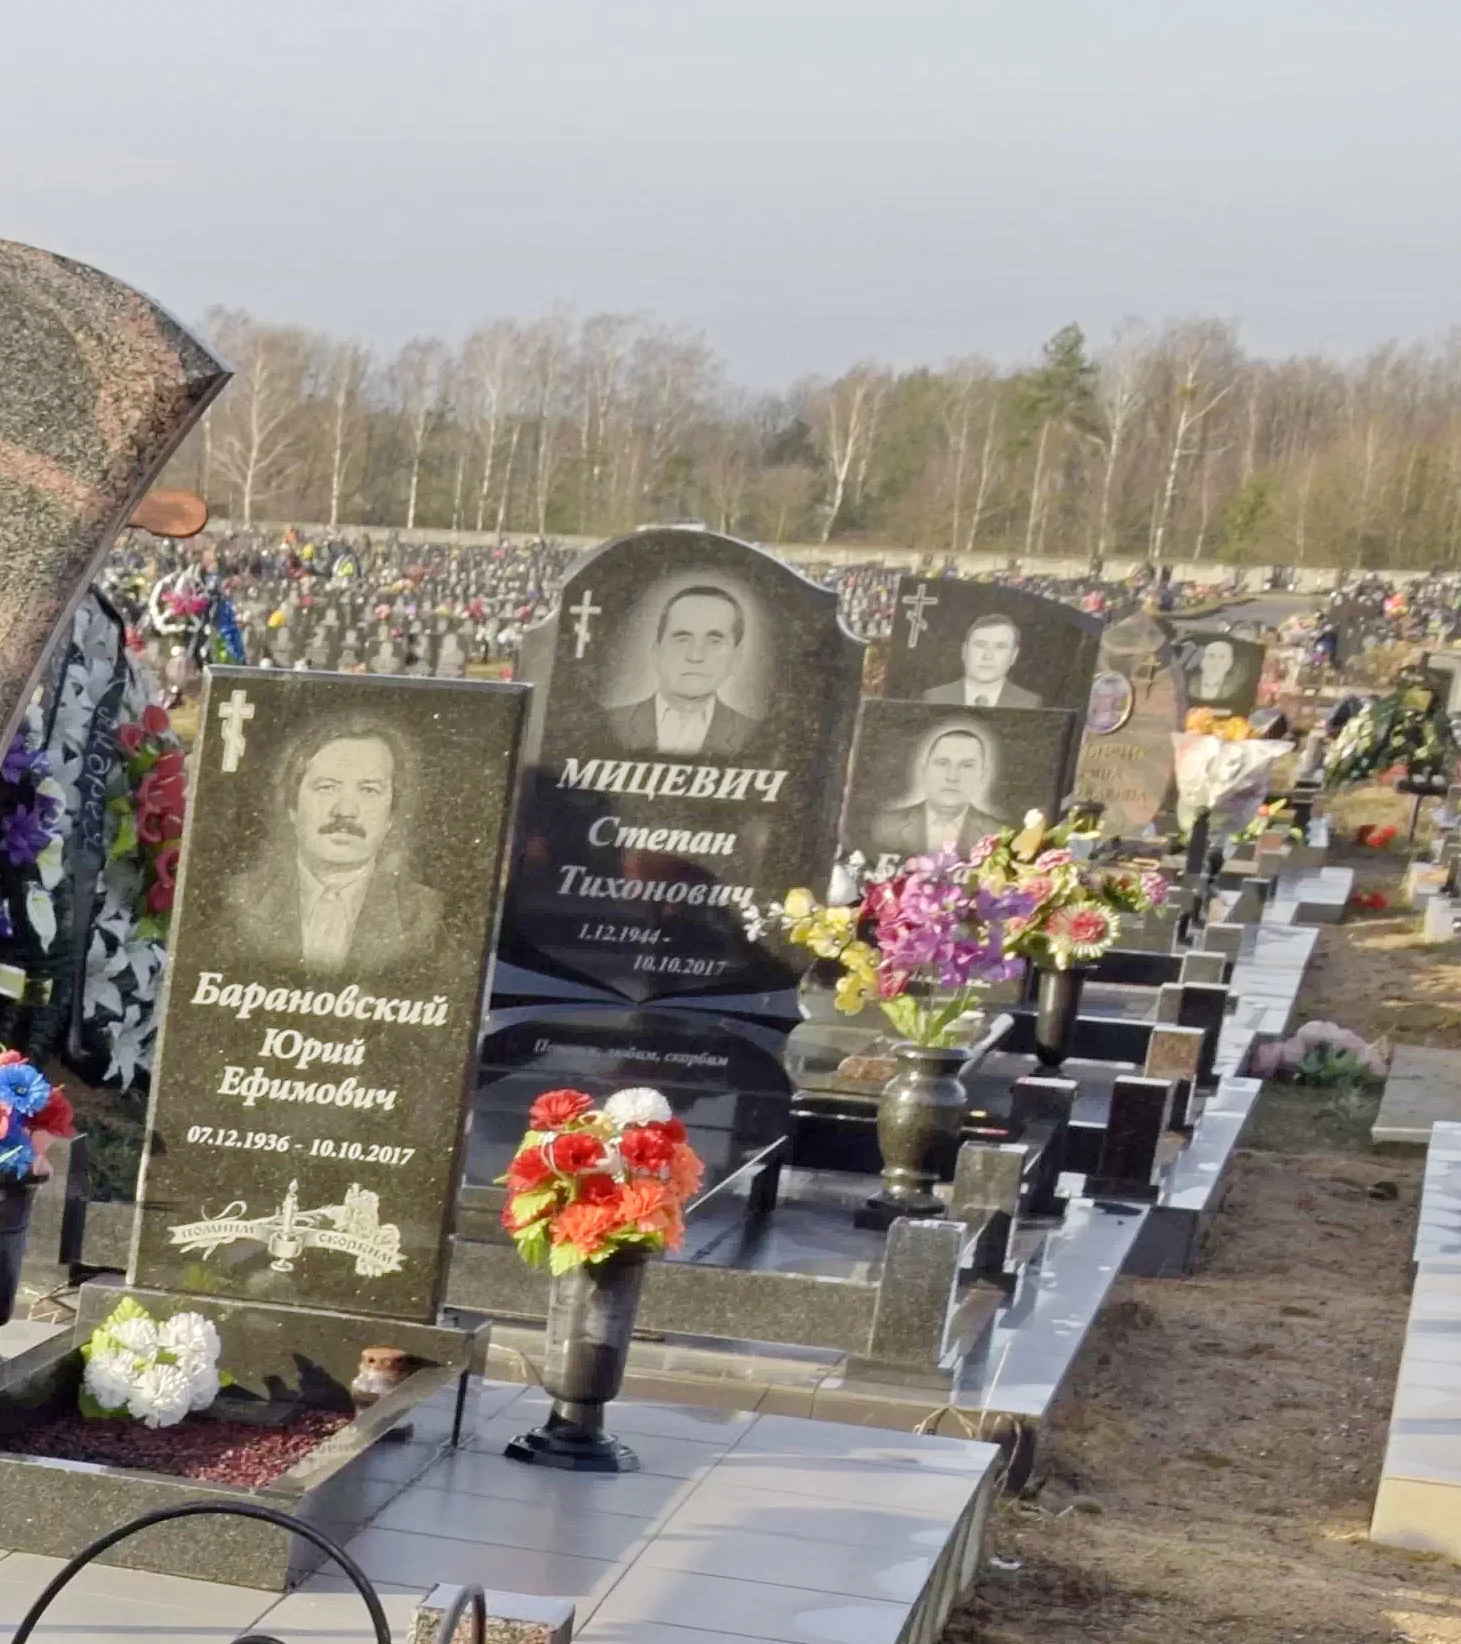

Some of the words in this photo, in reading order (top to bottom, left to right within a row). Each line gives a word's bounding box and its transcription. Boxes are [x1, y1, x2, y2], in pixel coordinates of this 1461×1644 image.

[556, 758, 788, 802] МИЦЕВИЧ
[588, 816, 737, 855] Степан
[557, 865, 754, 906] Тихонович
[190, 972, 449, 1026] Барановский
[258, 1028, 366, 1069] Юрий
[217, 1065, 397, 1111] Ефимович
[186, 1125, 291, 1152] 07.12.1936
[309, 1138, 416, 1165] 10.10.2017
